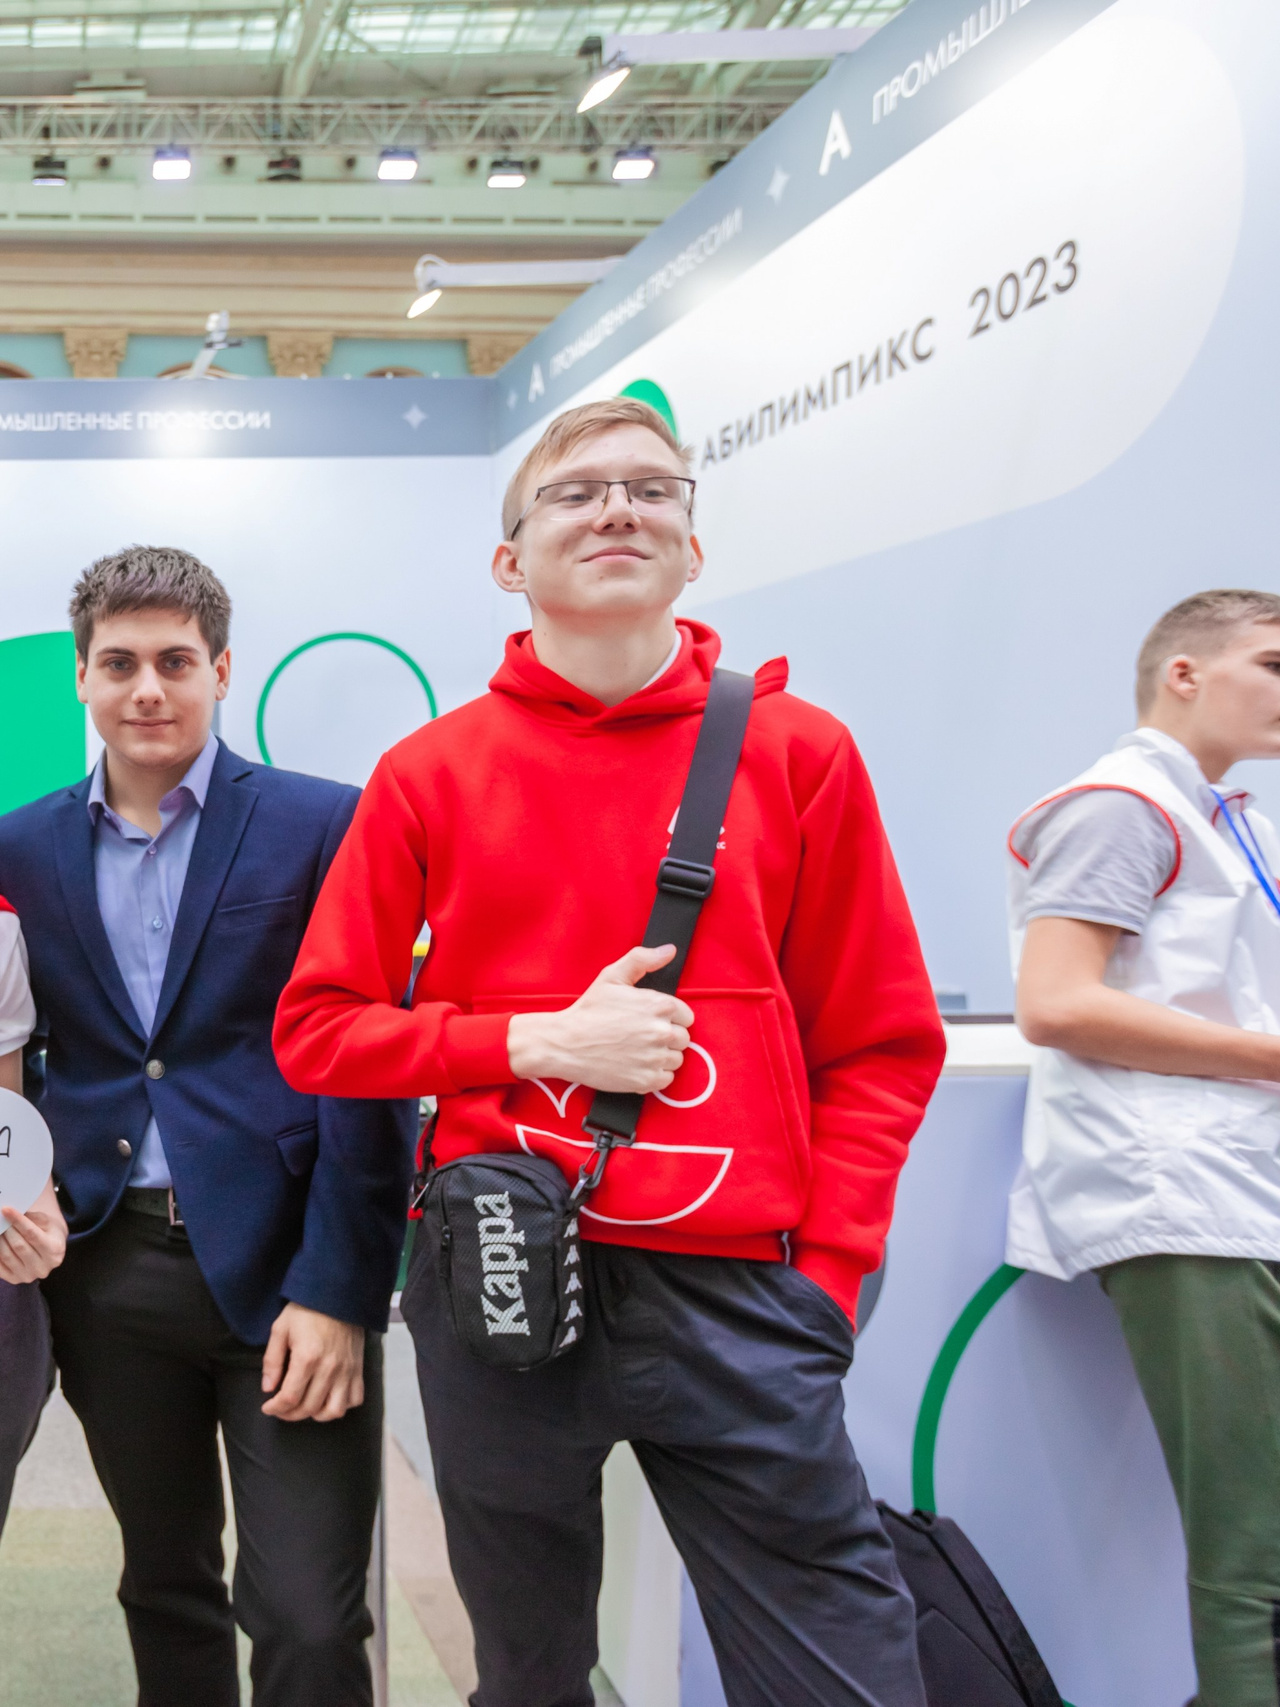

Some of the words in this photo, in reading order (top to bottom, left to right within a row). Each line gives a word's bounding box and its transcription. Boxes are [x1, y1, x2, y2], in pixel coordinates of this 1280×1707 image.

[872, 0, 1032, 124] ПРОМЫШЛ
[136, 410, 272, 431] ПРОФЕССИИ
[701, 316, 936, 470] АБИЛИМПИКС
[968, 240, 1079, 340] 2023
[473, 1190, 532, 1336] Kappa
